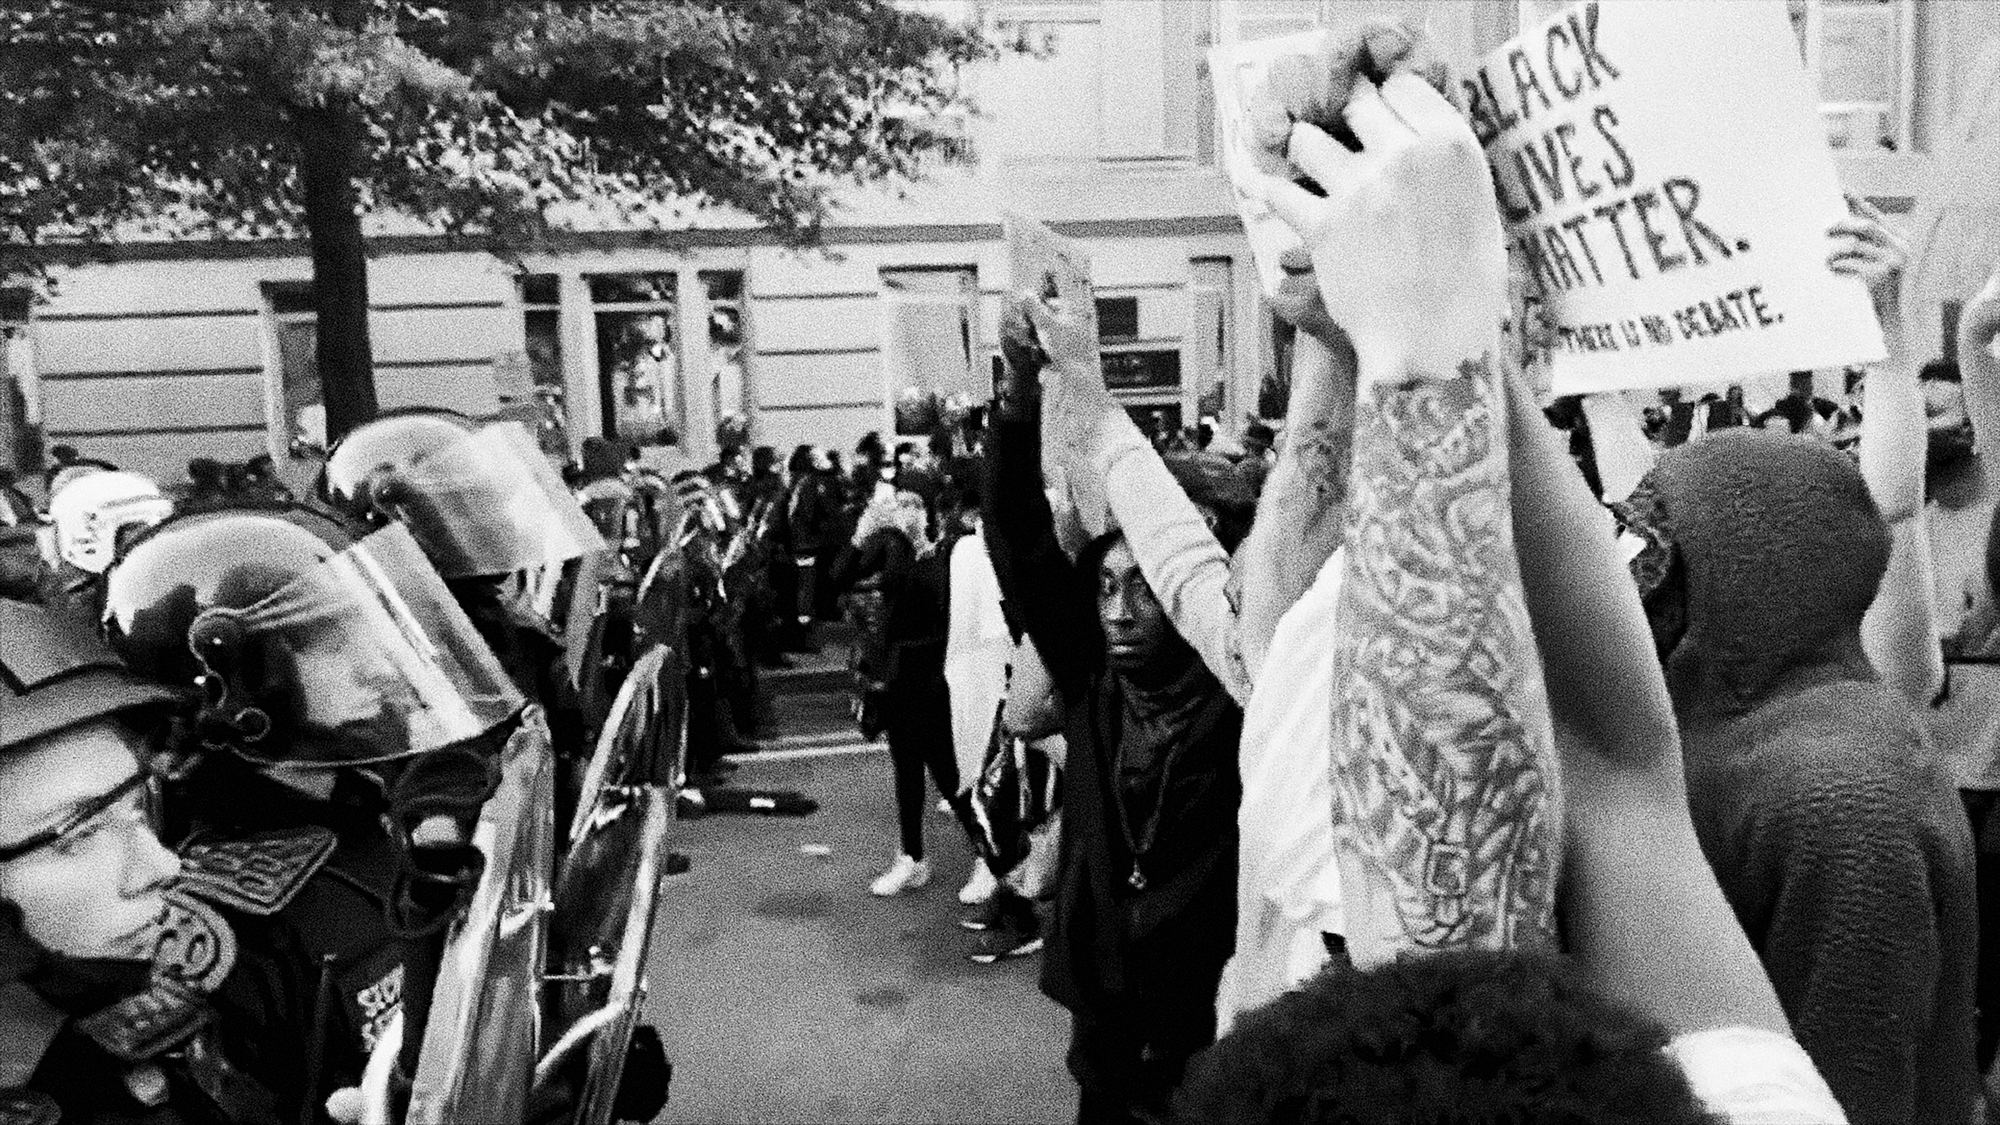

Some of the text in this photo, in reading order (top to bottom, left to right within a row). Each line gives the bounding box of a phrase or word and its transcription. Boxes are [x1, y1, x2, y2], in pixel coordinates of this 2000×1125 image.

[1461, 2, 1620, 147] BLACK
[1488, 104, 1635, 224] LIVES
[1516, 176, 1750, 297] MATTER.
[1673, 284, 1784, 340] DEBATE.
